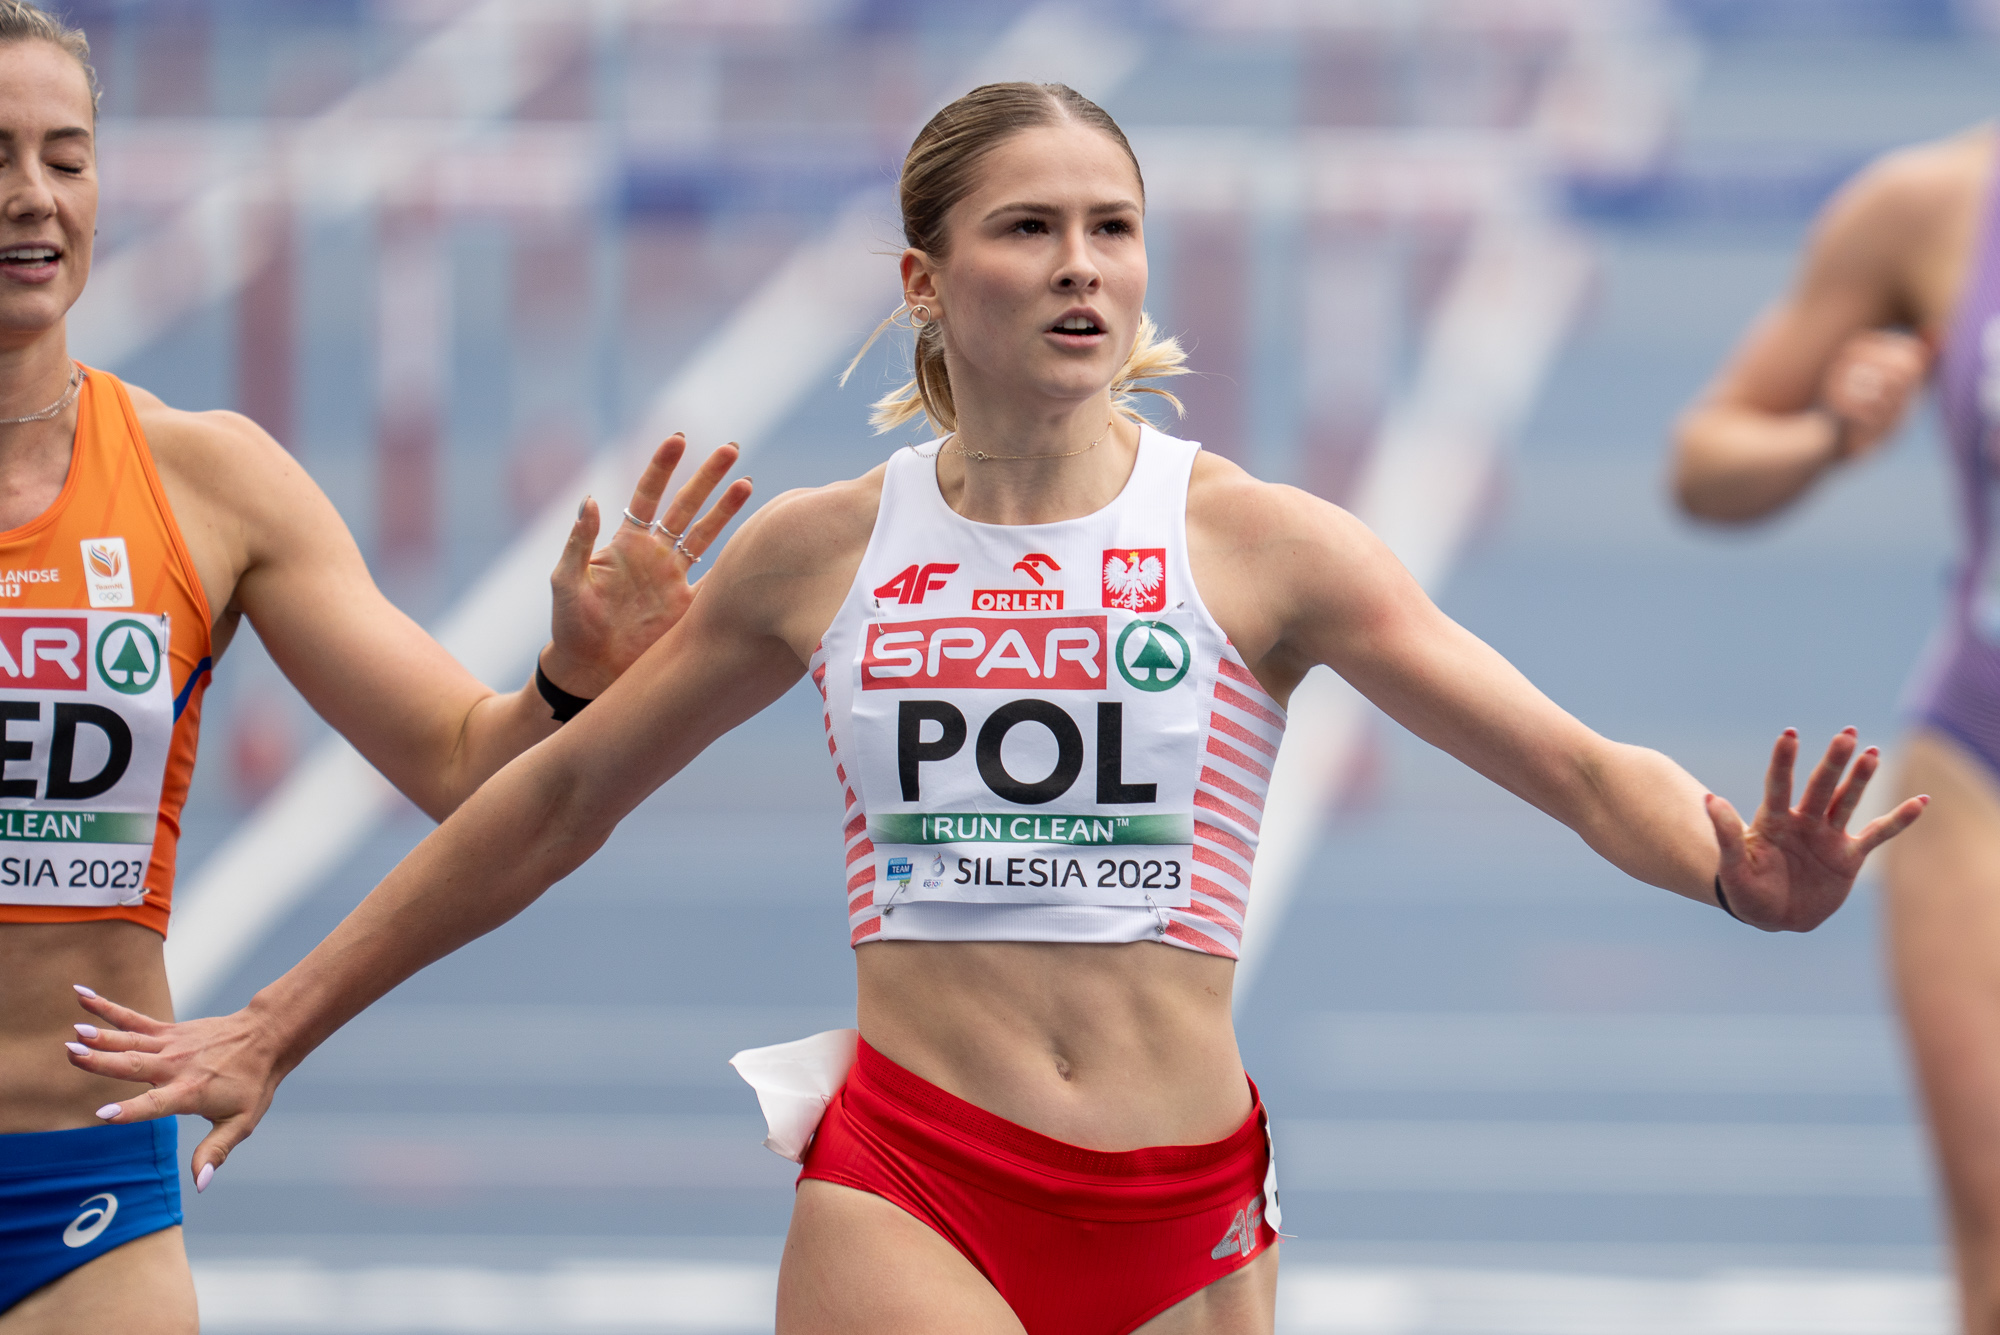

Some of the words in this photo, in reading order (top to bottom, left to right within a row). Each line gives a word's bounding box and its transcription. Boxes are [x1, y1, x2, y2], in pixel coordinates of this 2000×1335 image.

[873, 562, 960, 605] 4F
[976, 593, 1058, 610] ORLEN
[868, 627, 1100, 679] SPAR
[897, 698, 1157, 805] POL
[922, 817, 928, 840] I
[934, 816, 1001, 840] RUN
[0, 857, 59, 887] SIA
[68, 859, 142, 888] 2023
[892, 865, 910, 874] TEAM
[954, 857, 1087, 887] SILESIA
[1097, 859, 1181, 889] 2023
